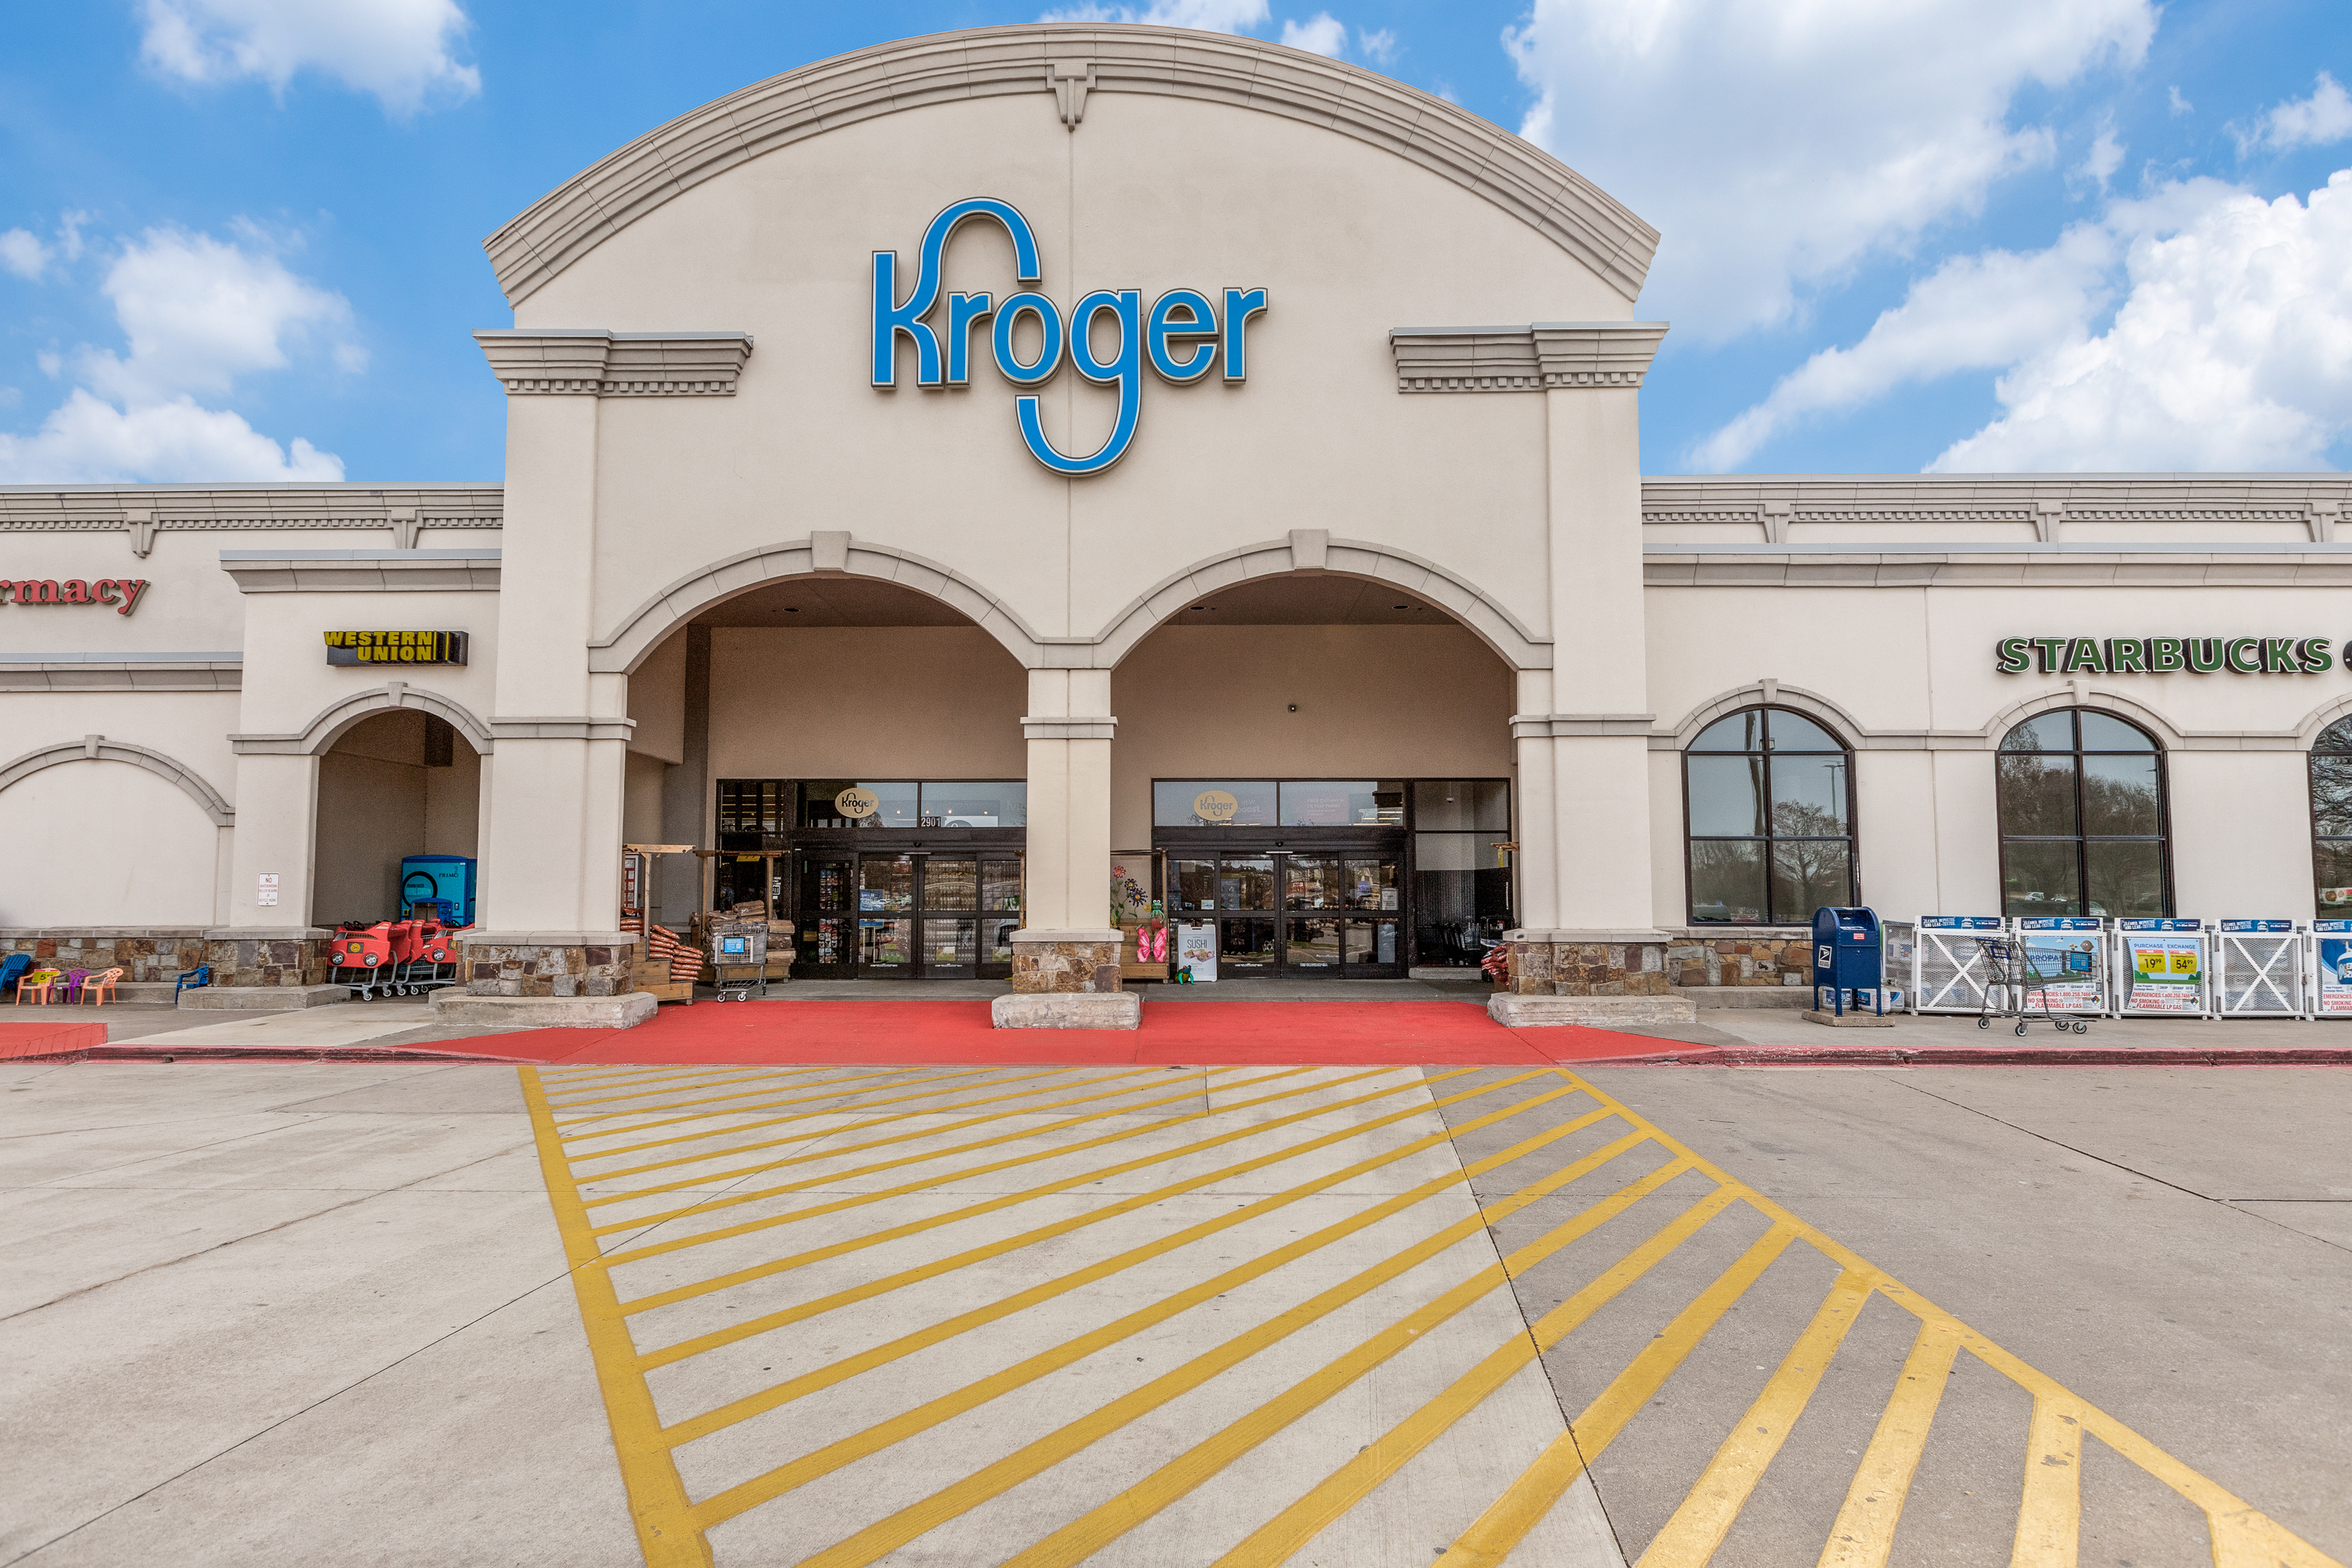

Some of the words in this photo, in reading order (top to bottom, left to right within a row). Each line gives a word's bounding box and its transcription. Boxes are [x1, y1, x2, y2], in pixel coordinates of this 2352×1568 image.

[870, 196, 1269, 477] Kroger
[323, 631, 432, 646] WESTERN
[357, 645, 432, 661] UNION
[1997, 636, 2335, 674] STARBUCKS
[841, 793, 875, 814] Kroger
[1200, 795, 1233, 817] Kroger
[920, 818, 941, 827] 2901
[1187, 939, 1207, 949] SUSHI
